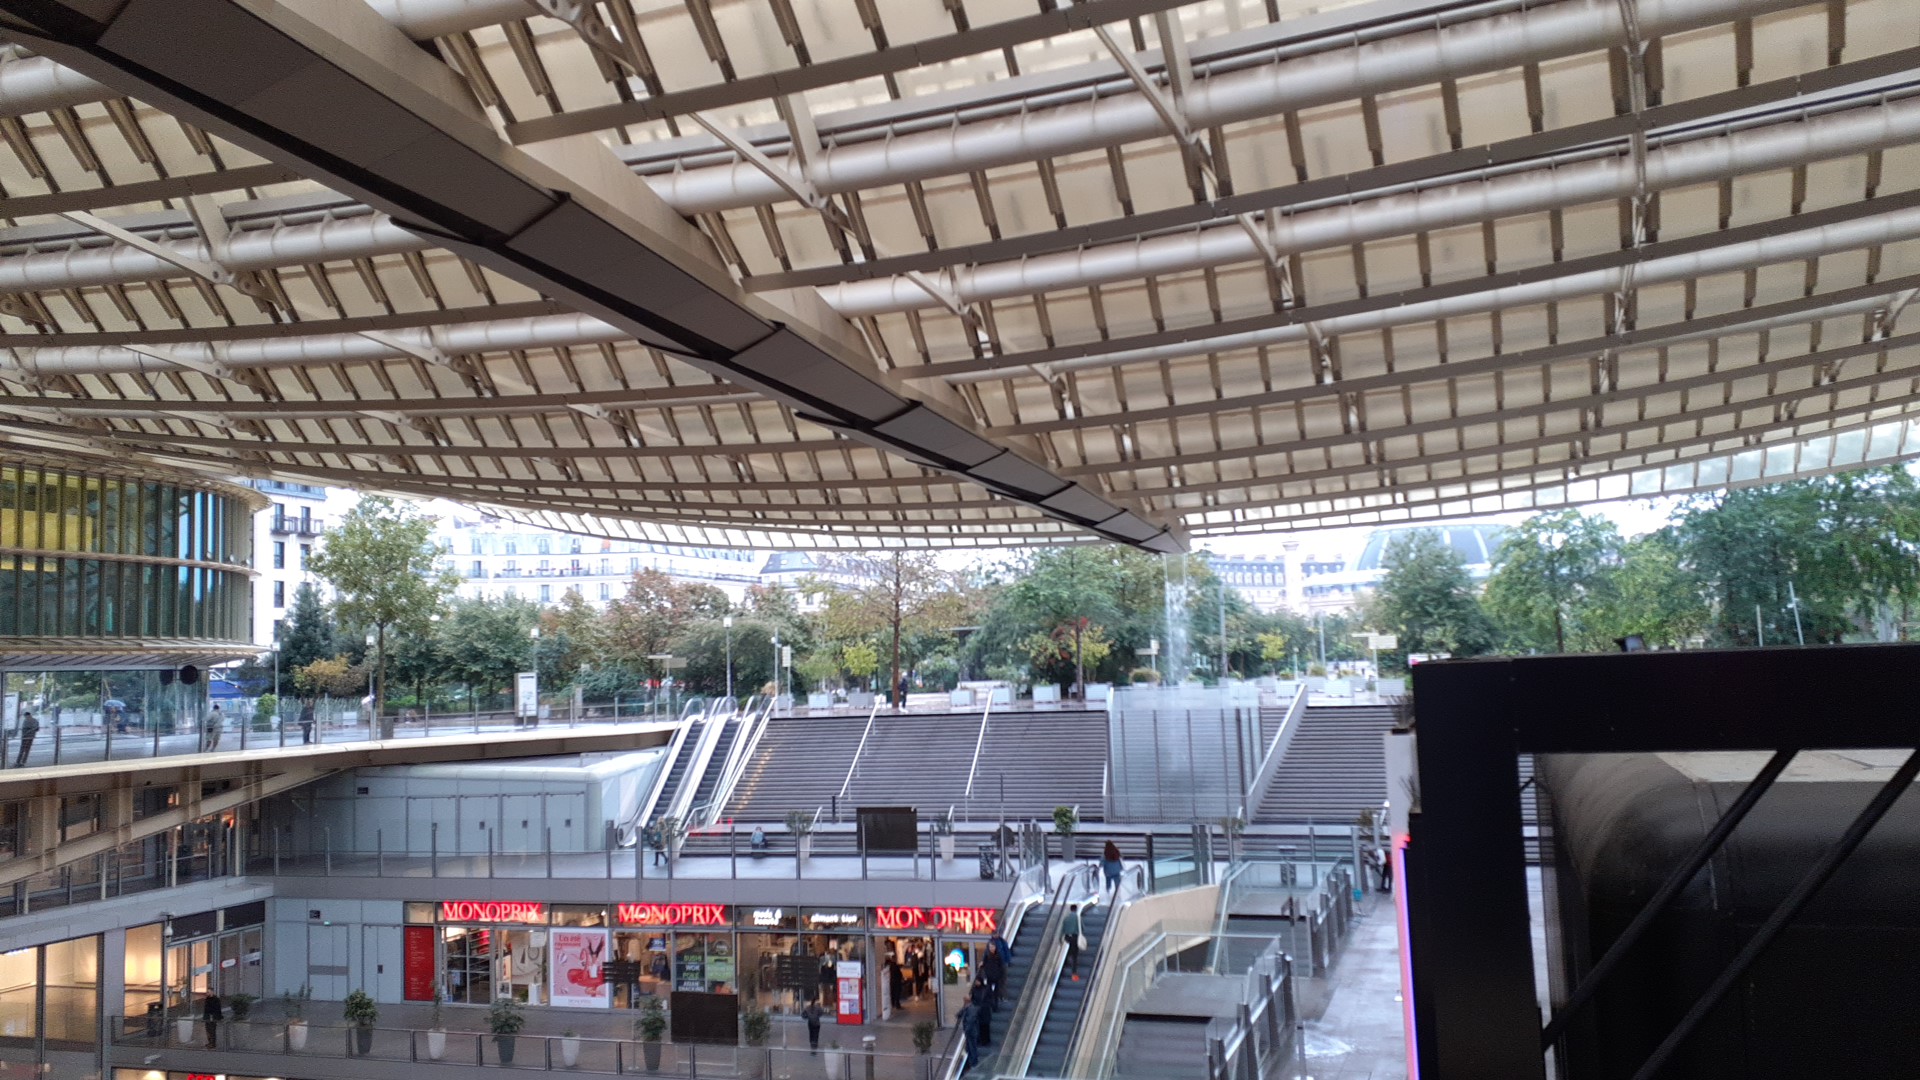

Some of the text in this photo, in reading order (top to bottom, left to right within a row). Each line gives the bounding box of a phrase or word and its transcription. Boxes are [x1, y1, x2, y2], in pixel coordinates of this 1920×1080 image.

[443, 901, 542, 921] MONOPRIX
[618, 903, 726, 925] MONOPRIX
[877, 905, 996, 930] MONOPRIX
